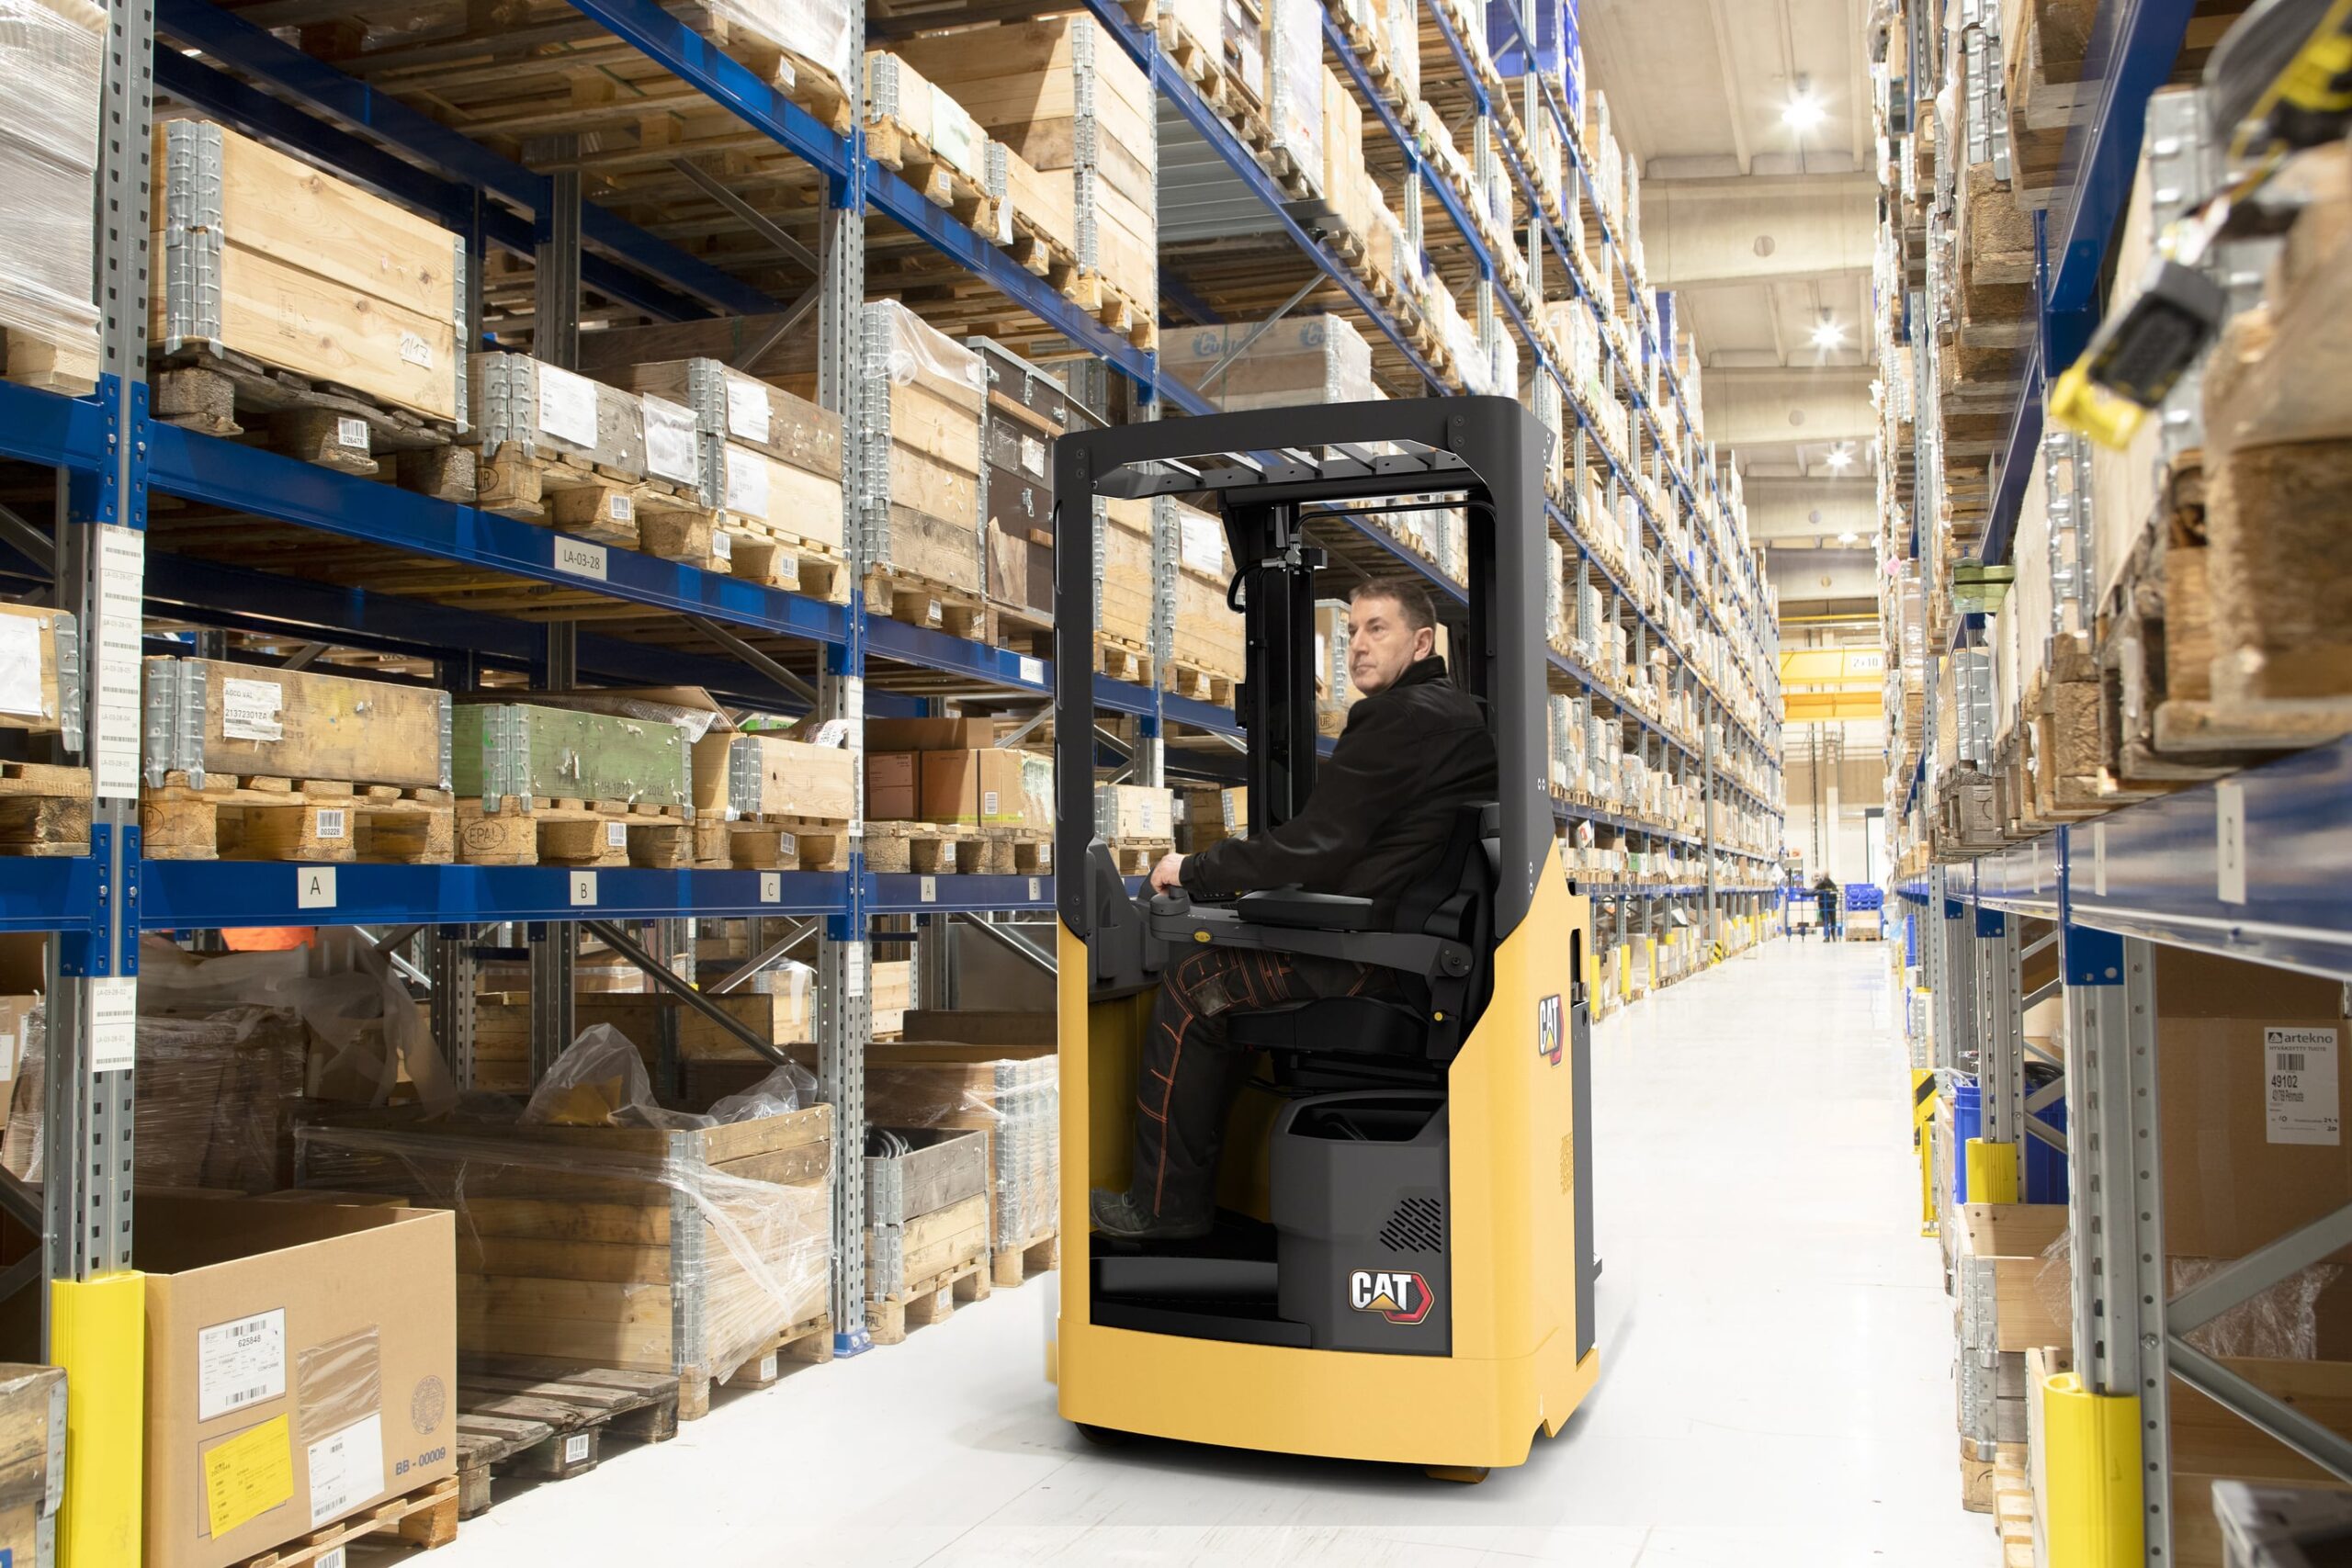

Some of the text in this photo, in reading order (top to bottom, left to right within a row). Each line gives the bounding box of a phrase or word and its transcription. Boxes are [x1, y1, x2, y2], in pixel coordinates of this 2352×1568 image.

[563, 549, 600, 570] LA-03-28
[647, 784, 664, 797] 2012
[469, 828, 501, 846] EPAL
[310, 875, 322, 896] A
[580, 883, 588, 899] B
[767, 883, 774, 897] C
[1540, 995, 1559, 1054] CAT
[2284, 1032, 2333, 1043] artekno
[2271, 1075, 2298, 1088] 49102
[1351, 1271, 1412, 1311] CAT
[865, 1314, 882, 1327] PAL
[238, 1335, 261, 1348] 625848
[395, 1459, 410, 1476] BB
[419, 1446, 446, 1467] 00009
